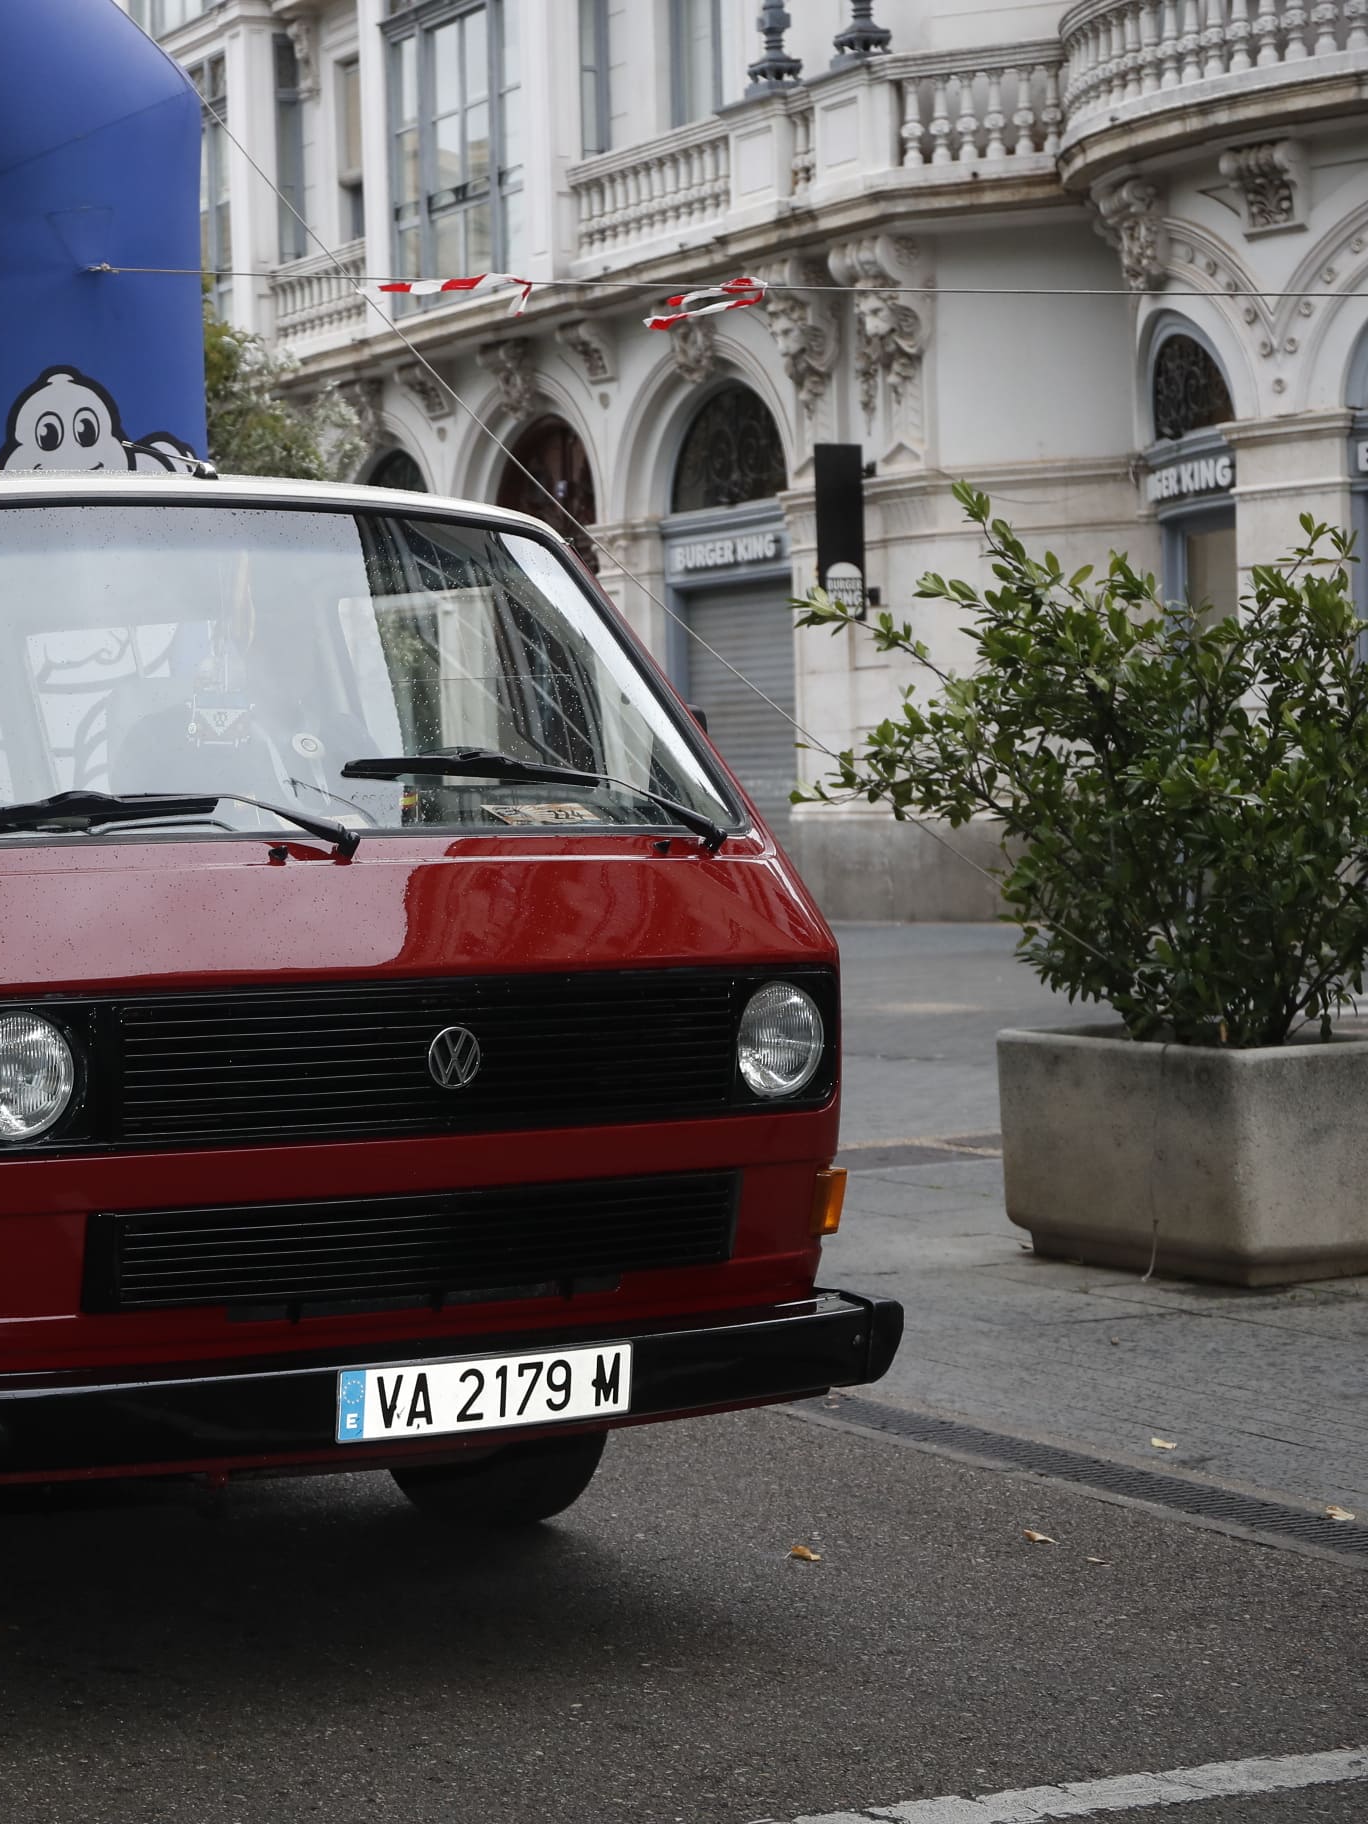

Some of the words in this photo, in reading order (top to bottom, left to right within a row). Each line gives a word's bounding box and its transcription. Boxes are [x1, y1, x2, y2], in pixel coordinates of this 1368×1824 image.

[1179, 456, 1233, 493] KING
[675, 539, 734, 571] BURGER
[736, 532, 777, 562] KING
[826, 577, 863, 590] BURGER
[376, 1372, 433, 1430] VA
[456, 1359, 573, 1423] 2179
[591, 1352, 621, 1407] M
[345, 1413, 358, 1429] E
